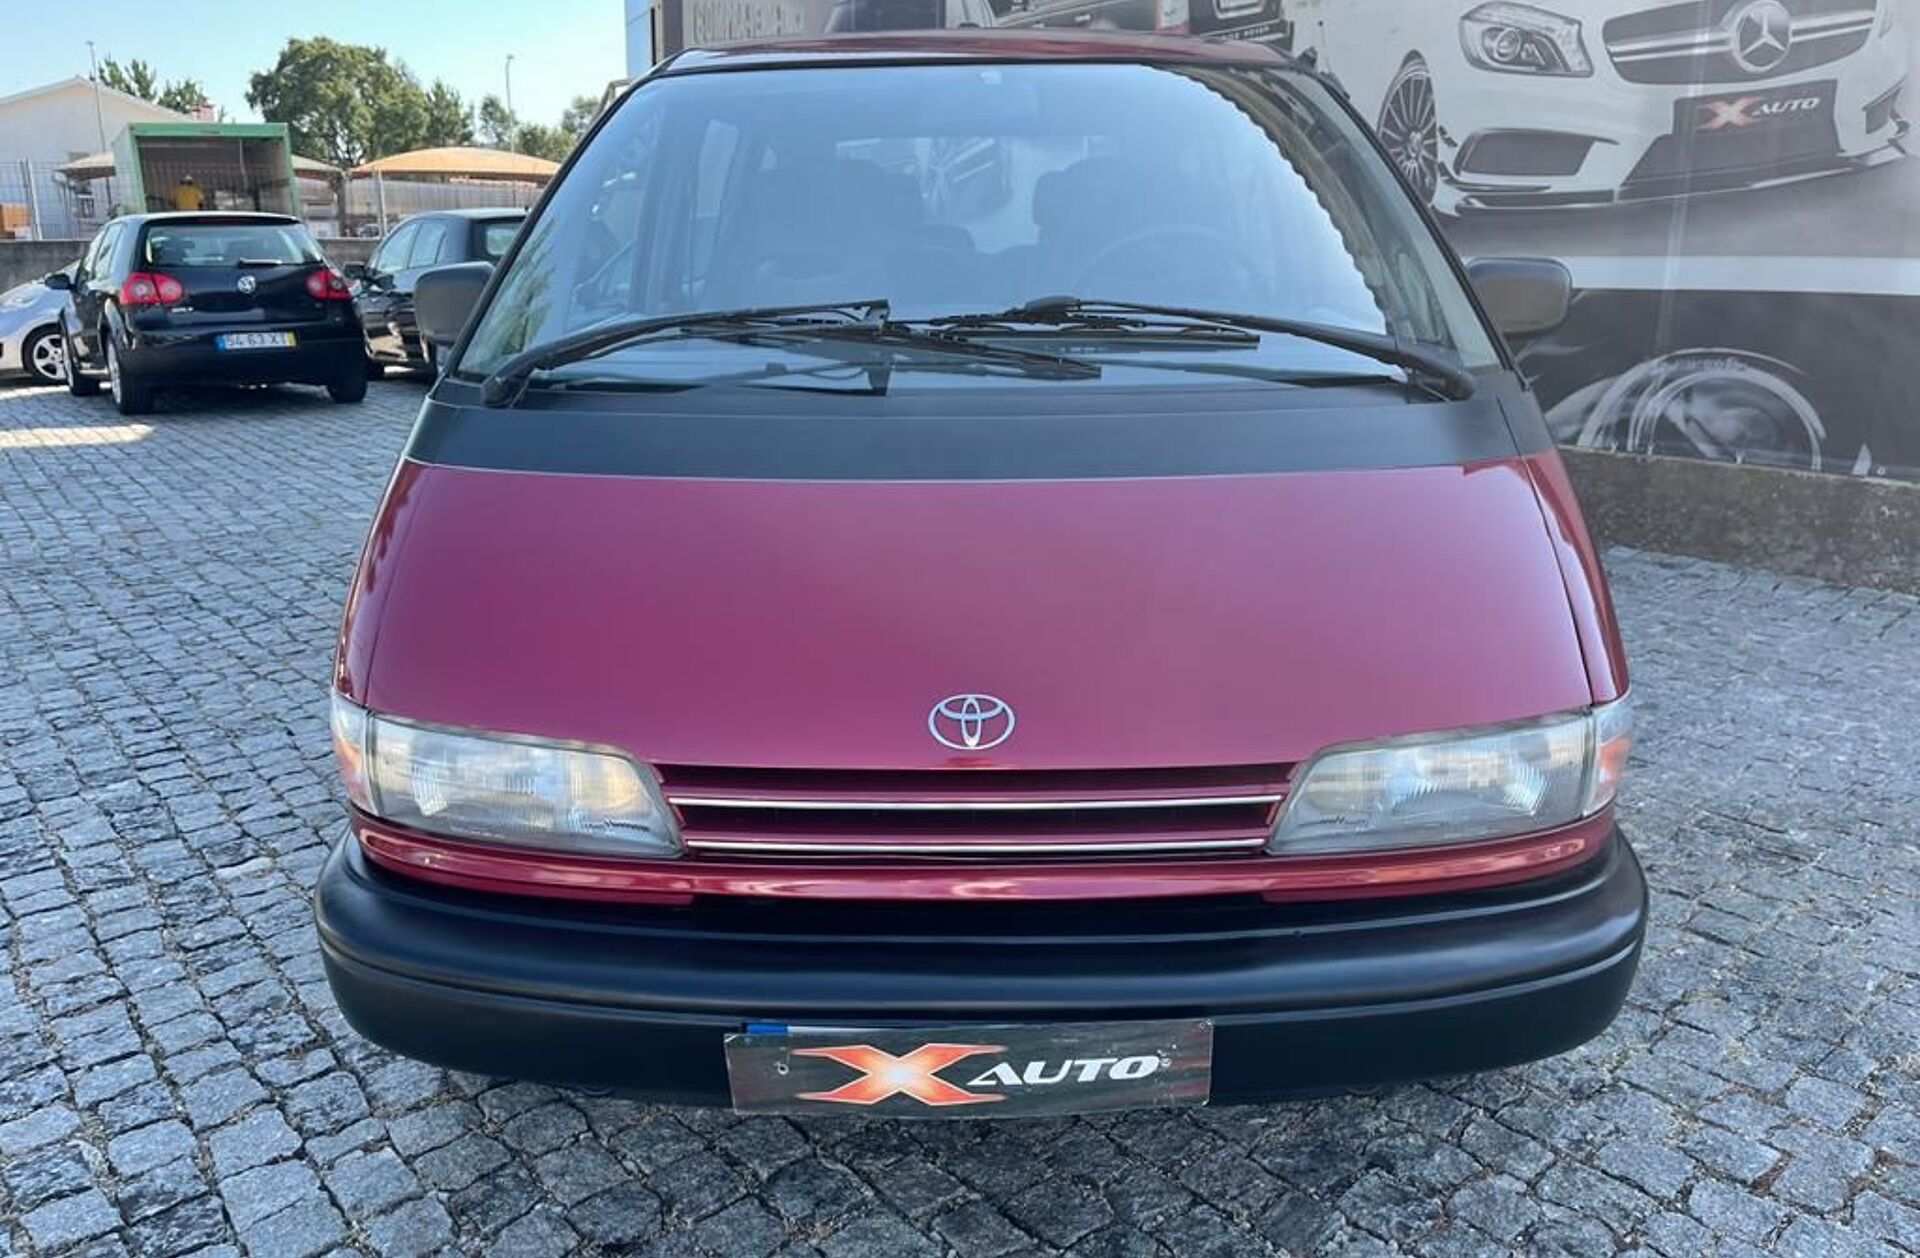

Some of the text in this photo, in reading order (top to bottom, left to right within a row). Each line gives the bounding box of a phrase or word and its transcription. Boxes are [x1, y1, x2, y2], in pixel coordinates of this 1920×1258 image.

[1752, 98, 1819, 116] AUTO
[791, 1043, 1160, 1106] X AUTO
